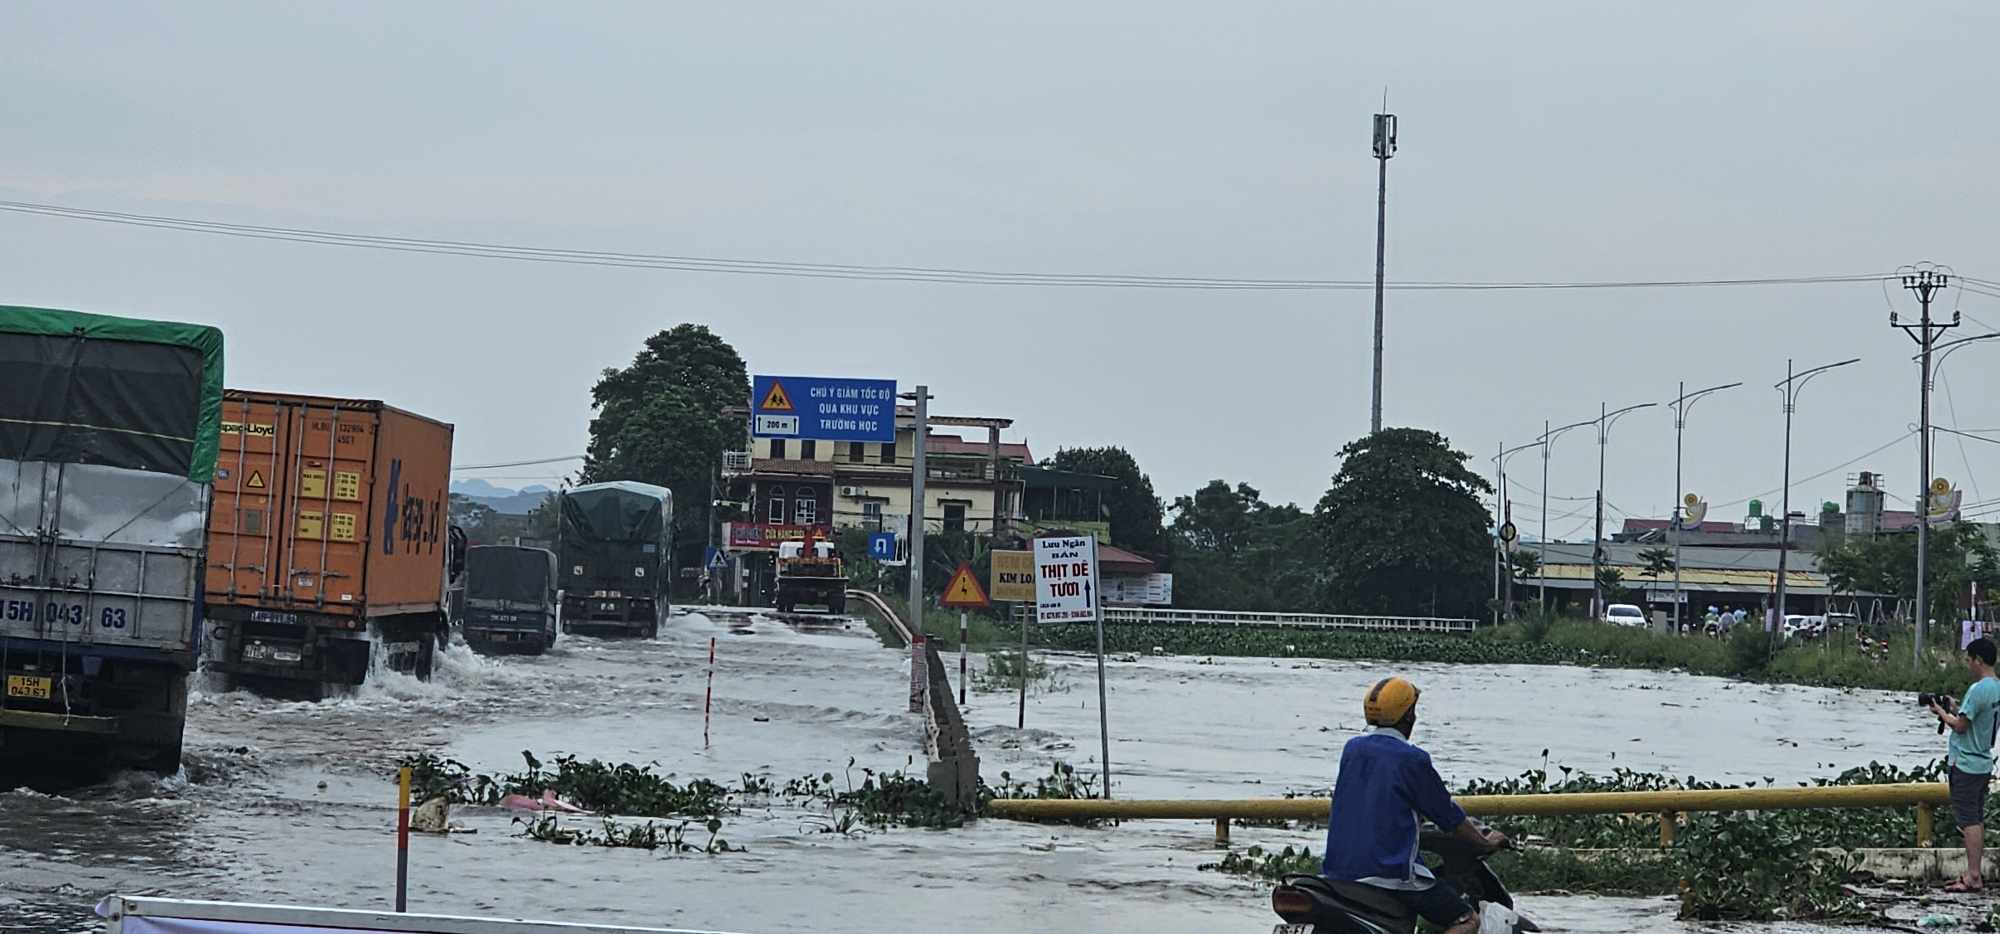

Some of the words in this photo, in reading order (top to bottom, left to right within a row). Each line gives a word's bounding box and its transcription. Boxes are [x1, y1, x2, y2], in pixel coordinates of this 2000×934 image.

[810, 386, 827, 398] CHÚ
[861, 386, 877, 399] TỐC
[879, 387, 890, 402] ĐỘ
[819, 403, 837, 414] QUA
[840, 403, 857, 414] KHU
[861, 403, 879, 417] VỰC
[767, 420, 780, 429] 200
[820, 418, 856, 431] TRƯỜNG
[859, 420, 878, 432] HỌC
[1042, 540, 1060, 549] Lưu
[1040, 563, 1069, 580] THỊT
[1000, 573, 1017, 584] KIM
[1020, 573, 1036, 585] LO
[1050, 581, 1080, 598] TƯƠI
[0, 600, 33, 622] 15H
[46, 602, 82, 625] 043
[101, 607, 126, 628] 63
[22, 677, 40, 687] 15H
